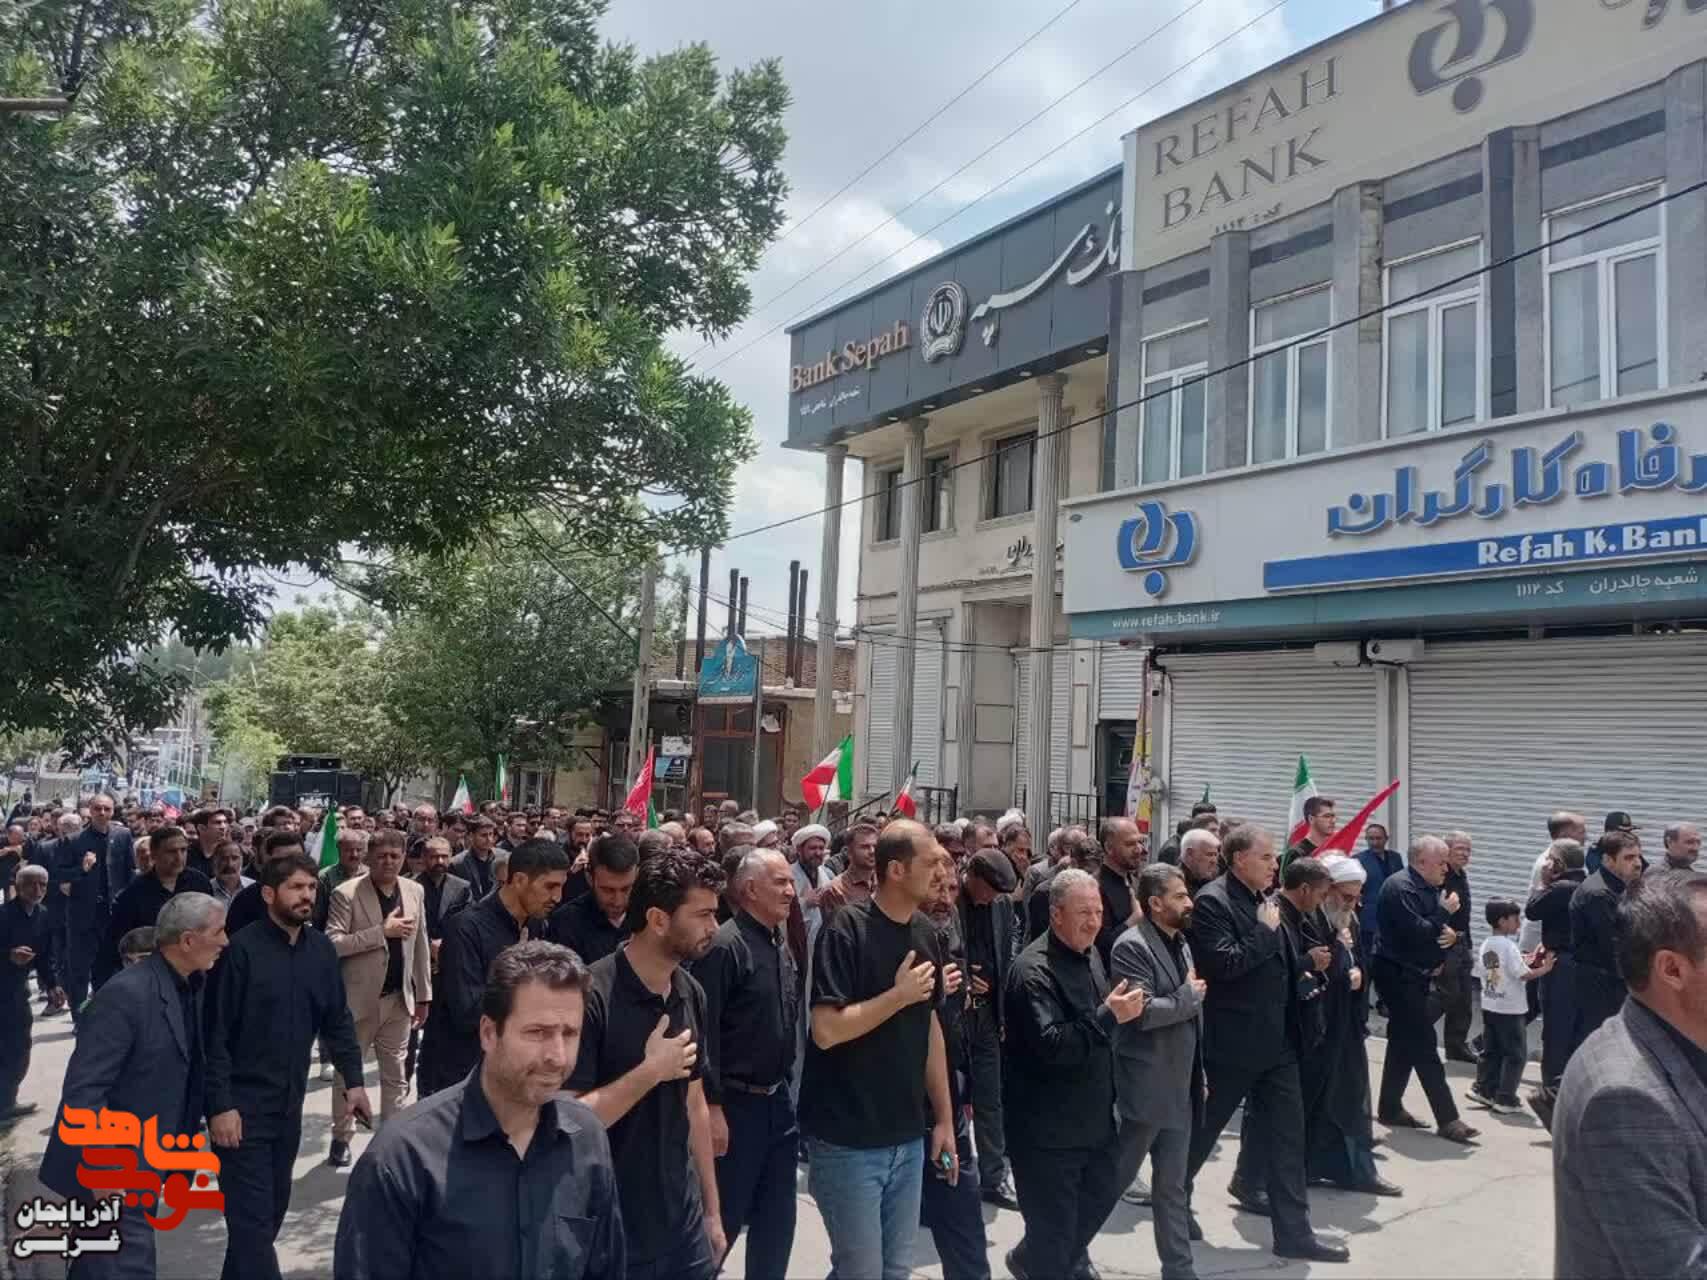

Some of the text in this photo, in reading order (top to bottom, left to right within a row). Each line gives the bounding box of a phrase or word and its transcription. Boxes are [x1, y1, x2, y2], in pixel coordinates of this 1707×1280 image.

[1155, 56, 1342, 176] REFAH
[1161, 126, 1328, 229] BANK
[791, 320, 909, 392] Bank Sepah
[1326, 430, 1584, 537] کارگران
[1477, 534, 1574, 565] Refah
[1584, 528, 1617, 555] K.
[1545, 580, 1564, 595] کد
[1589, 574, 1651, 596] چالدران
[1112, 608, 1221, 629] www.refah-bank.ir
